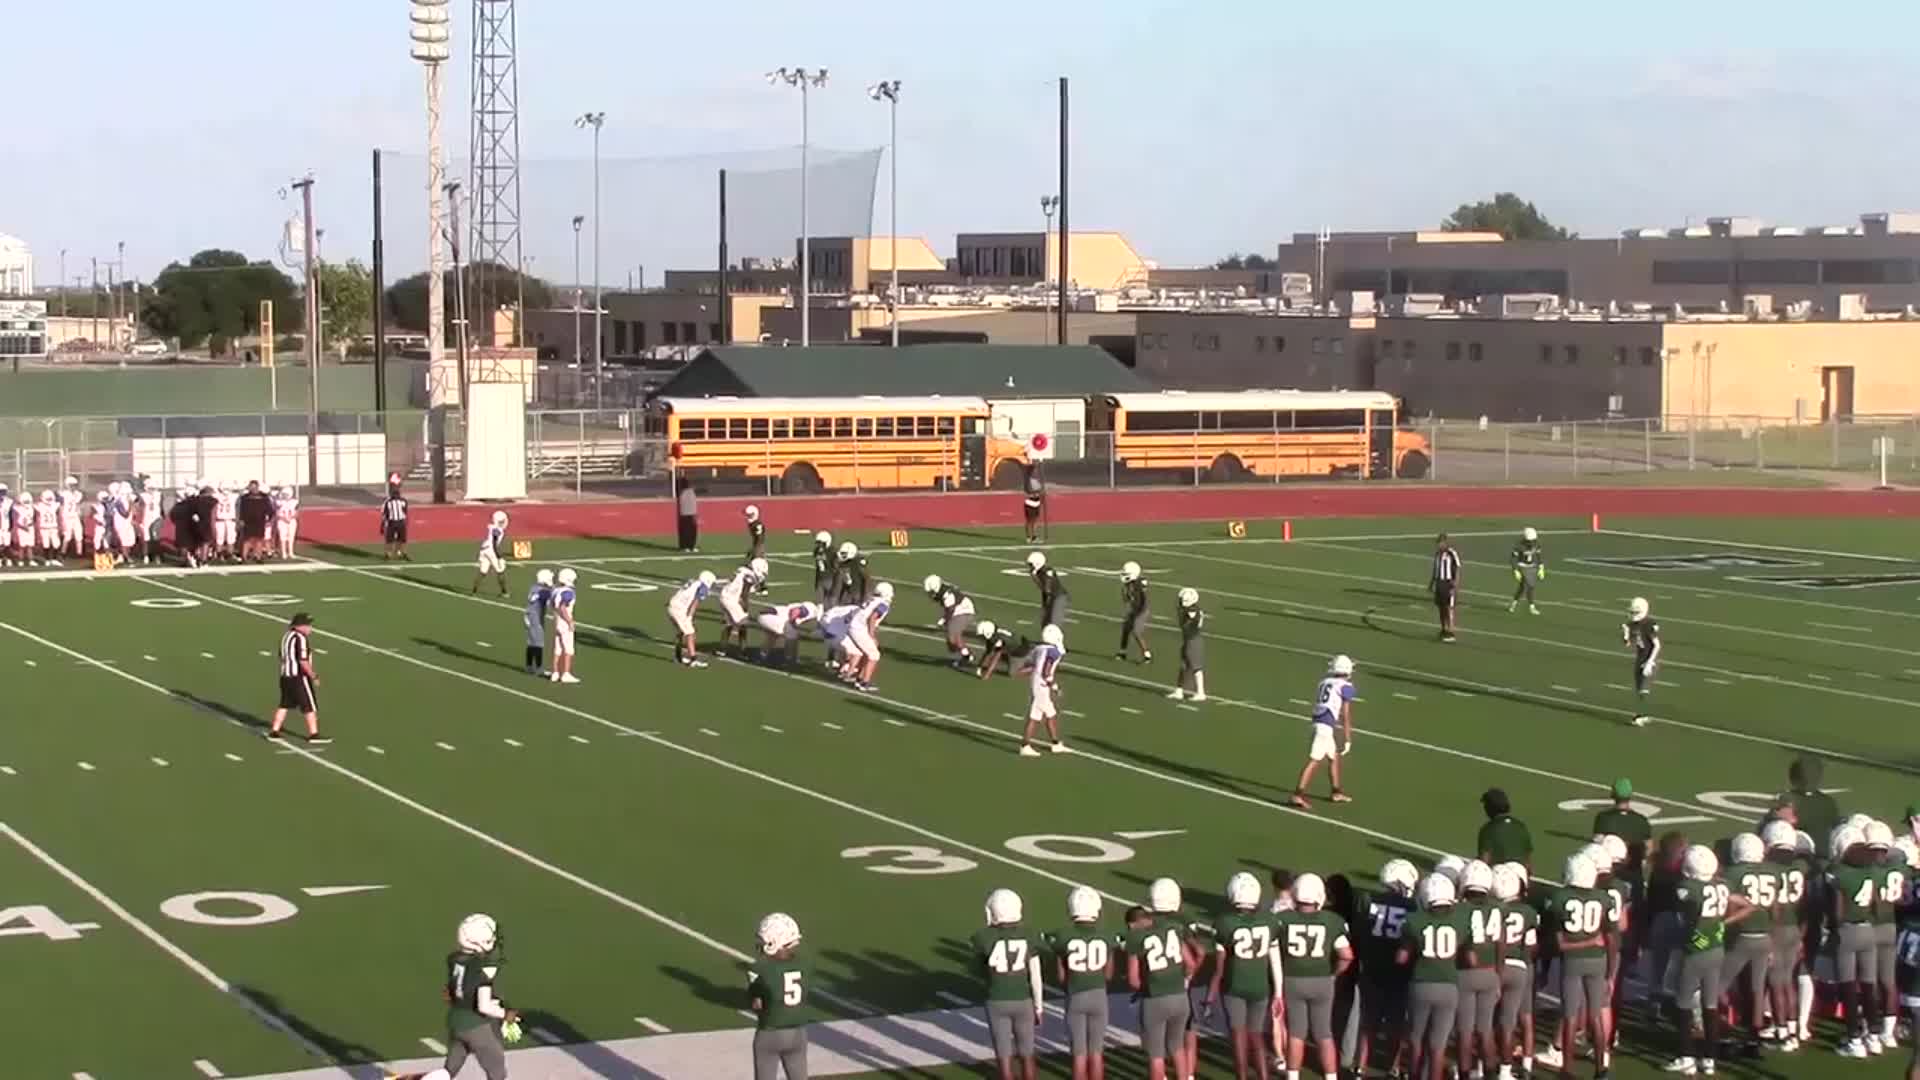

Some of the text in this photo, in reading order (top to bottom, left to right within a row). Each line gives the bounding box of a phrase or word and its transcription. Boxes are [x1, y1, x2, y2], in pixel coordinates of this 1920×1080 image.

[894, 530, 907, 546] 10
[1702, 884, 1729, 918] 28
[1741, 874, 1777, 907] 35
[1779, 871, 1804, 904] 13
[1369, 903, 1407, 938] 75
[1564, 899, 1602, 933] 30
[988, 940, 1028, 972] 47
[1067, 939, 1108, 972] 20
[1143, 930, 1183, 972] 24
[1233, 926, 1270, 959] 27
[1288, 924, 1327, 958] 57
[1422, 925, 1457, 959] 10
[783, 971, 802, 1006] 5
